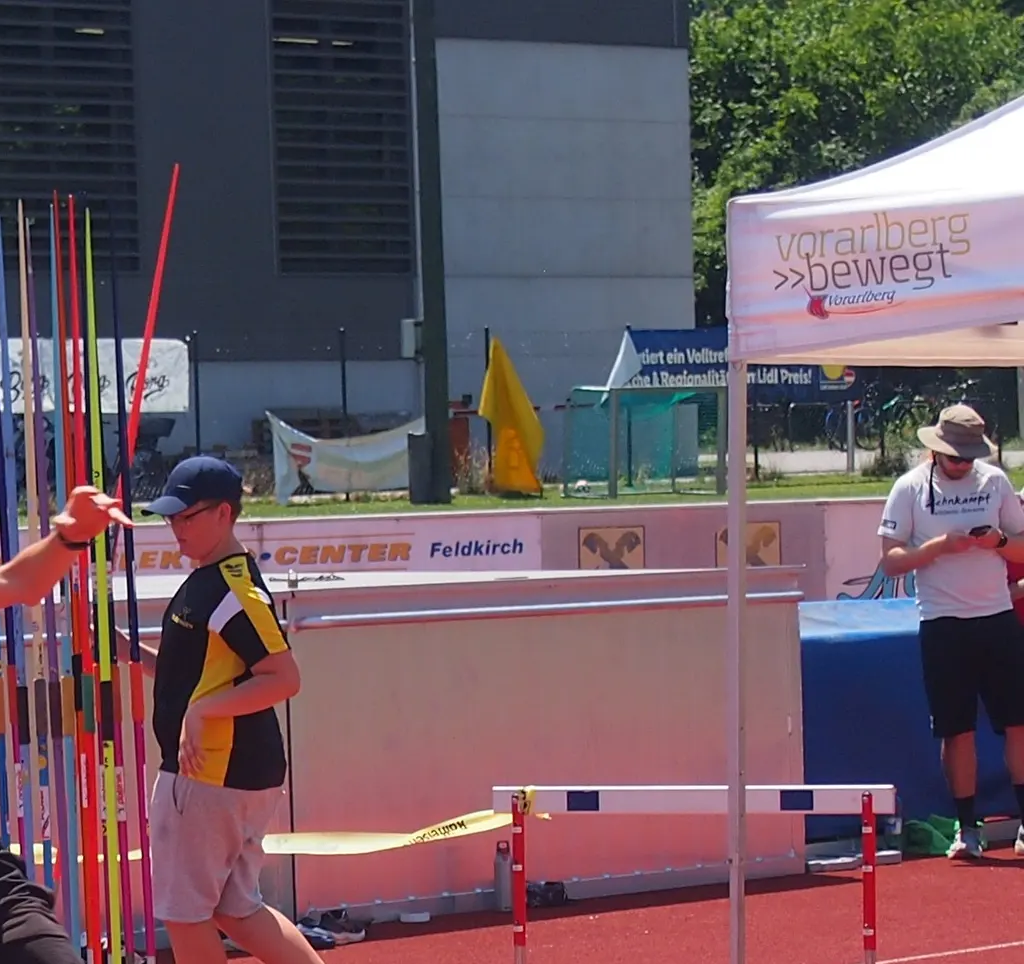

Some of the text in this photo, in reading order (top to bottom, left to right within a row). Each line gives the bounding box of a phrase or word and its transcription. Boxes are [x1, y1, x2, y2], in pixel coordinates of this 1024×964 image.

[776, 211, 970, 261] vorarlberg
[828, 290, 896, 306] Vorarlberg
[667, 348, 684, 364] ein
[758, 369, 777, 384] Lidl
[780, 369, 811, 385] Preis!
[274, 541, 411, 566] CENTER
[429, 538, 524, 559] Feldkirch
